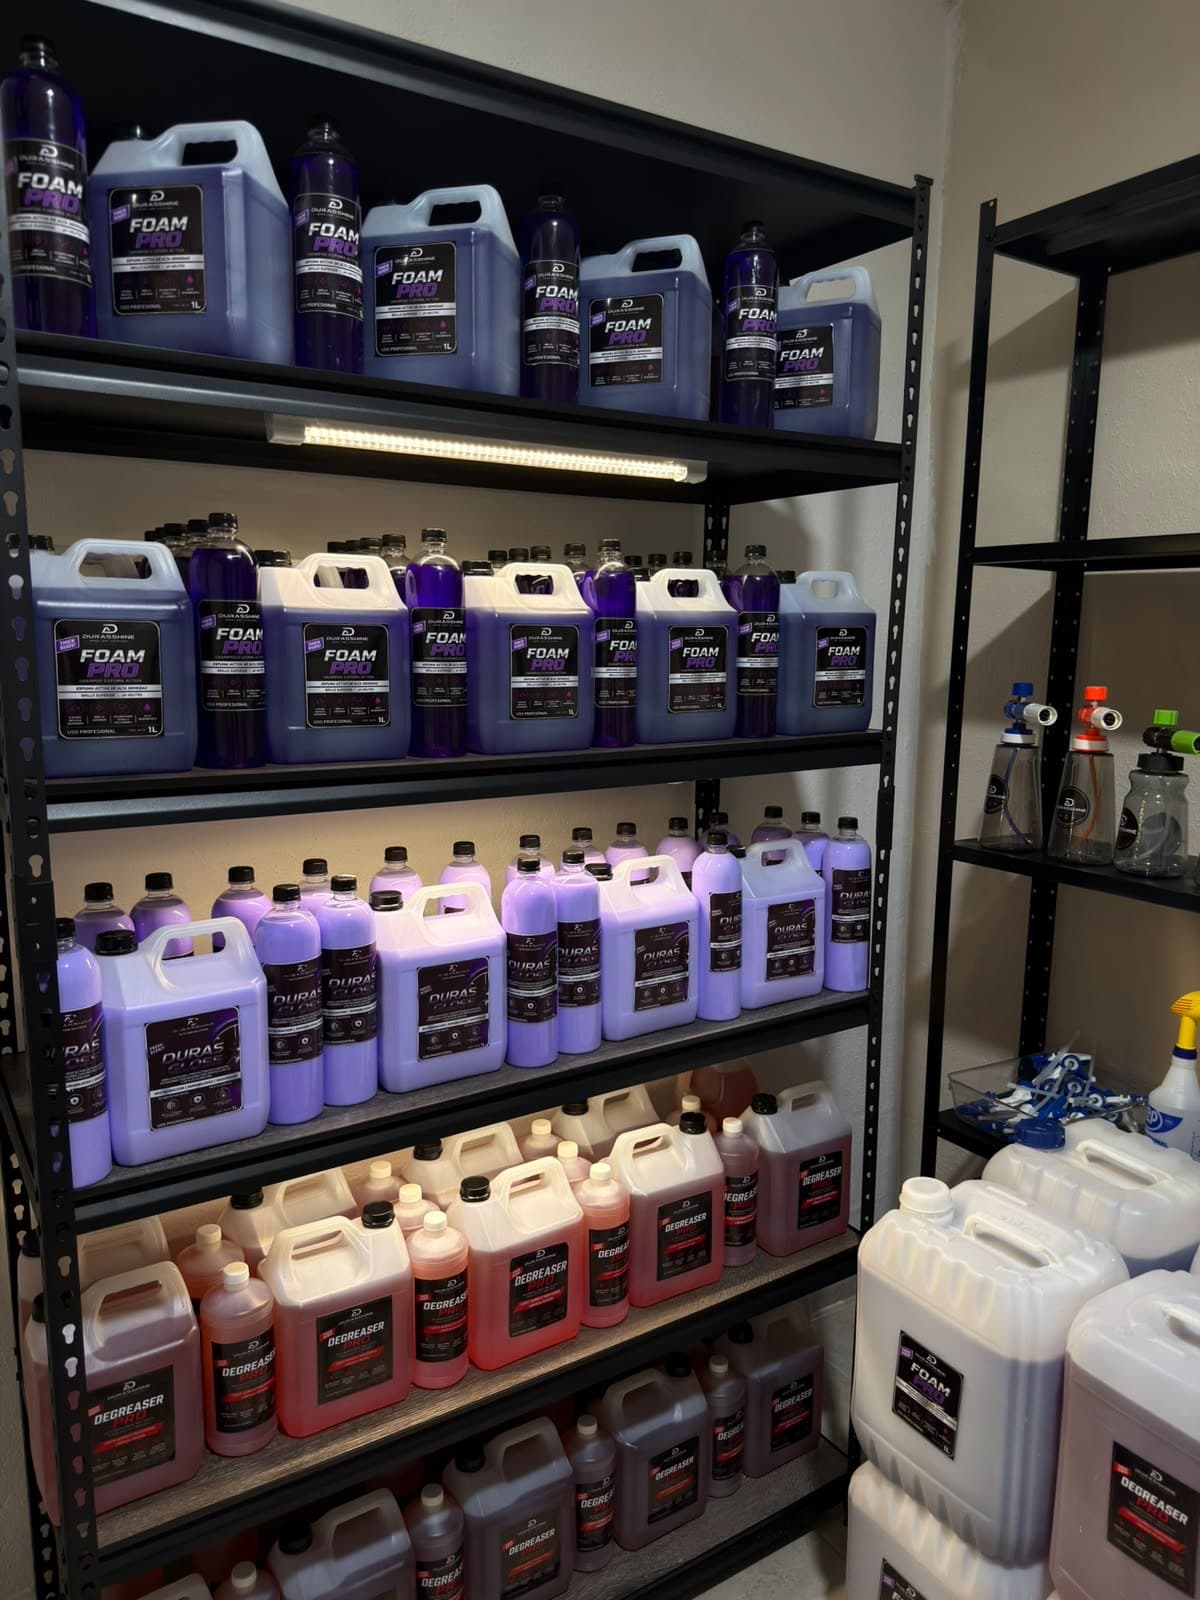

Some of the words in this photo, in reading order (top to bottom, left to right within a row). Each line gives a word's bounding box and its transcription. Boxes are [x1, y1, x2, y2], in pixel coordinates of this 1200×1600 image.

[17, 172, 83, 199] FOAM
[23, 187, 80, 215] PRO
[129, 216, 189, 233] FOAM
[135, 231, 183, 249] PRO
[308, 222, 359, 245] FOAM
[313, 236, 358, 257] PRO
[391, 269, 444, 286] FOAM
[396, 282, 438, 299] PRO
[536, 286, 579, 301] FOAM
[541, 297, 577, 314] PRO
[604, 318, 652, 333] FOAM
[742, 319, 776, 334] PRO
[608, 330, 648, 346] PRO
[780, 347, 824, 362] FOAM
[783, 358, 819, 373] PRO
[222, 640, 263, 655] PRO
[526, 647, 569, 659] FOAM
[609, 640, 637, 651] FOA
[682, 646, 720, 657] FOAM
[828, 646, 861, 657] FOAM
[80, 649, 146, 663] FOAM
[324, 649, 377, 662] FOAM
[613, 651, 637, 663] PR
[686, 656, 716, 668] PRO
[831, 655, 859, 666] PRO
[87, 662, 140, 679] PRO
[329, 661, 373, 675] PRO
[530, 658, 566, 671] PRO
[148, 726, 158, 735] 1L
[840, 889, 871, 901] DURA
[774, 922, 808, 936] DURAS
[643, 946, 681, 961] DURAS
[430, 986, 478, 1004] DURAS
[64, 1039, 99, 1058] RAS
[161, 1041, 225, 1065] DURAS
[802, 1166, 842, 1188] DEGREASER
[665, 1211, 708, 1233] DEGREASER
[514, 1260, 568, 1287] DEGREASER
[327, 1320, 386, 1348] DEGREASER
[910, 1362, 951, 1397] FOAM
[94, 1393, 165, 1426] DEGREASER
[655, 1456, 695, 1481] DEGREASER
[1120, 1476, 1188, 1526] DEGREASER
[509, 1528, 555, 1556] DEGREASER
